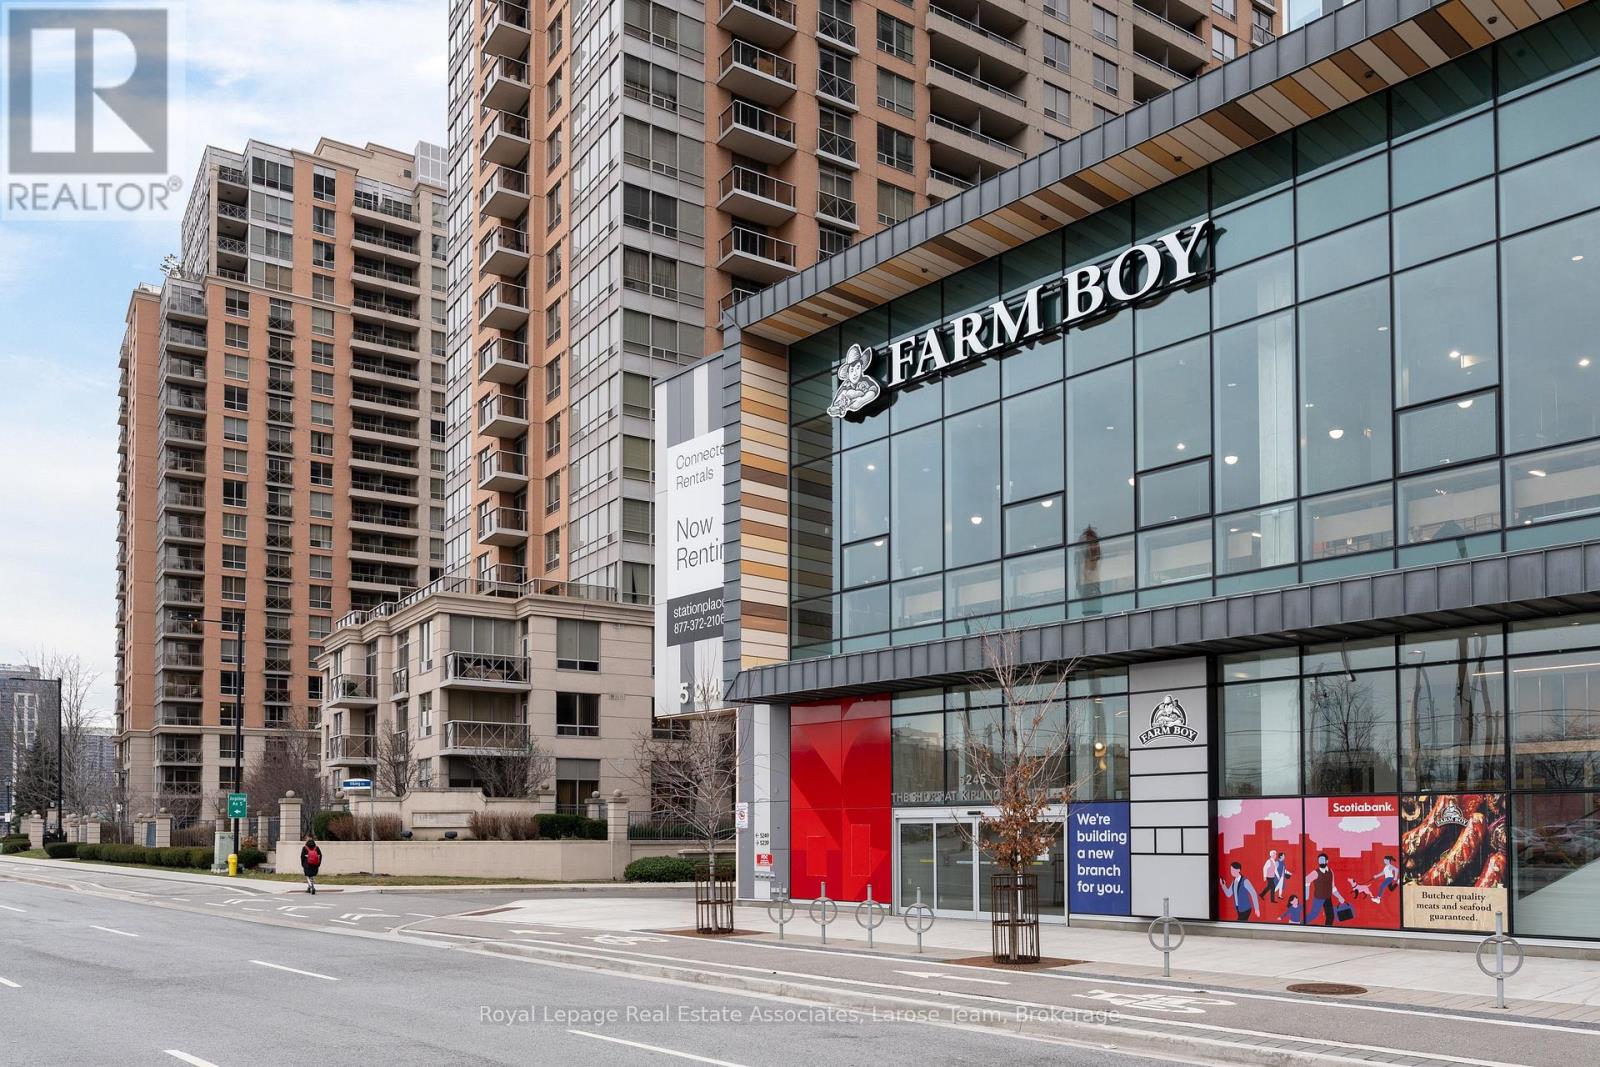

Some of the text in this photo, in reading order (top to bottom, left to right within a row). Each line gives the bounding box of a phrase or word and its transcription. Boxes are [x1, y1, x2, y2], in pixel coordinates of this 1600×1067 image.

[887, 219, 1211, 387] FARM BOY
[676, 467, 714, 490] Rentals
[676, 516, 713, 542] Now
[1140, 726, 1197, 743] FARM BOY
[891, 792, 909, 803] THE
[944, 790, 957, 801] AT
[1076, 812, 1111, 825] We're
[1076, 830, 1127, 845] building
[1077, 849, 1114, 859] a new
[1077, 864, 1121, 876] branch
[1077, 880, 1124, 896] for you.
[1421, 891, 1486, 903] Butcher quality
[1416, 902, 1492, 912] meats and seafood
[1429, 913, 1478, 922] guaranteed.
